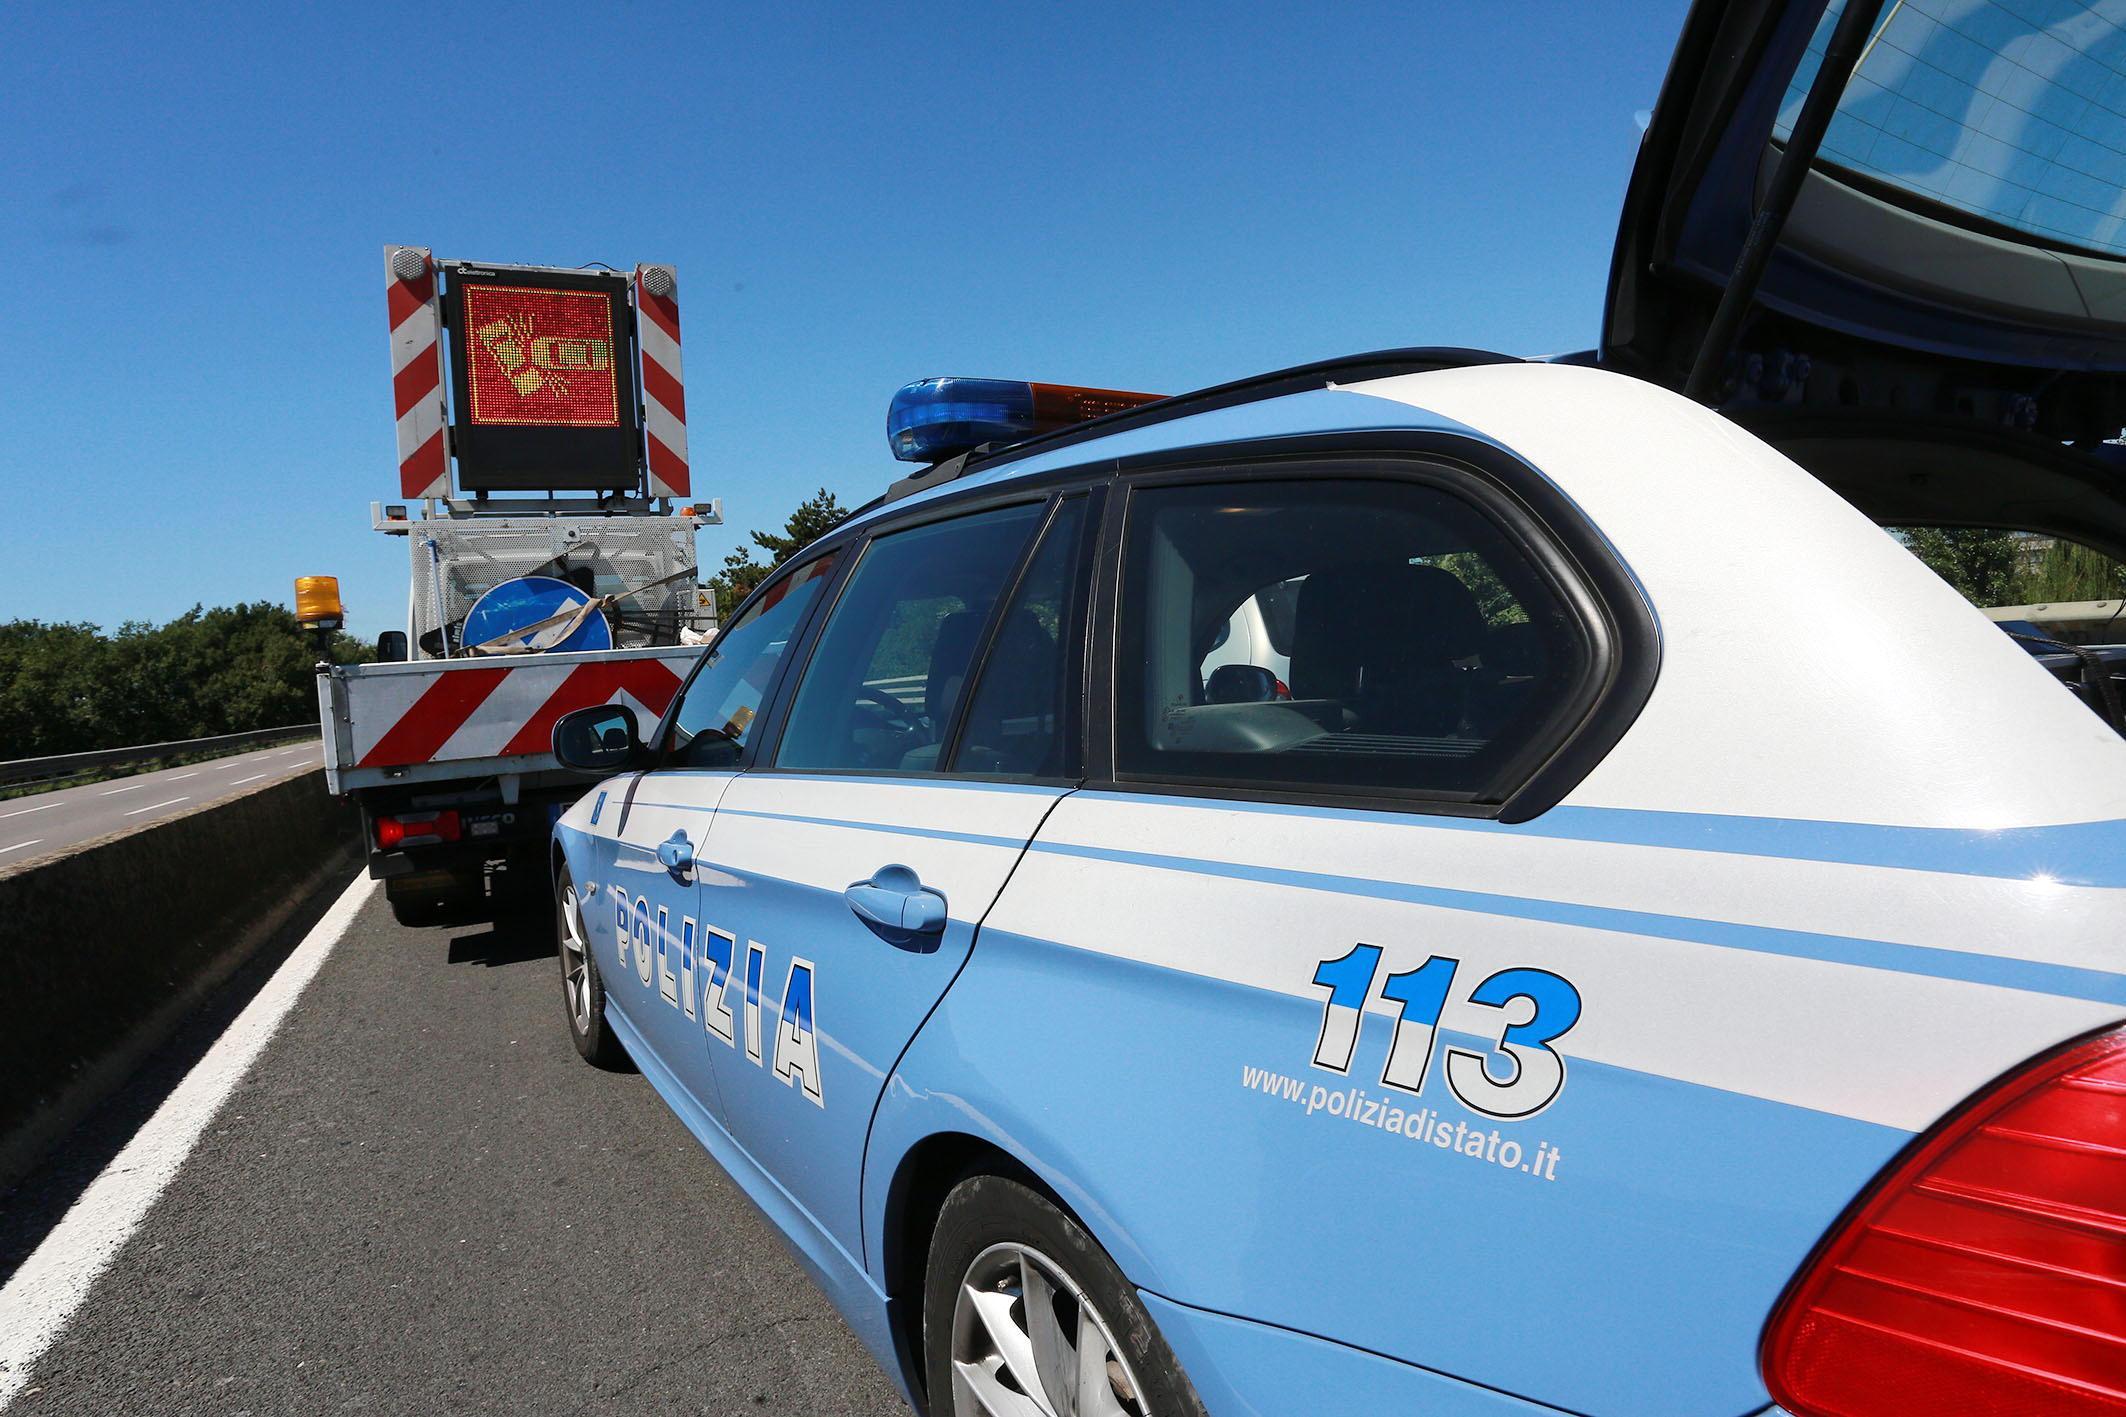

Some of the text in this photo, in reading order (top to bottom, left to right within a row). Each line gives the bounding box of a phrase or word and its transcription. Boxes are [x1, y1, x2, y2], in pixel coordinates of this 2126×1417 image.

[615, 885, 824, 1109] POLIZIA
[1309, 941, 1584, 1122] 113
[1242, 1065, 1561, 1181] www.poliziadistato.it
